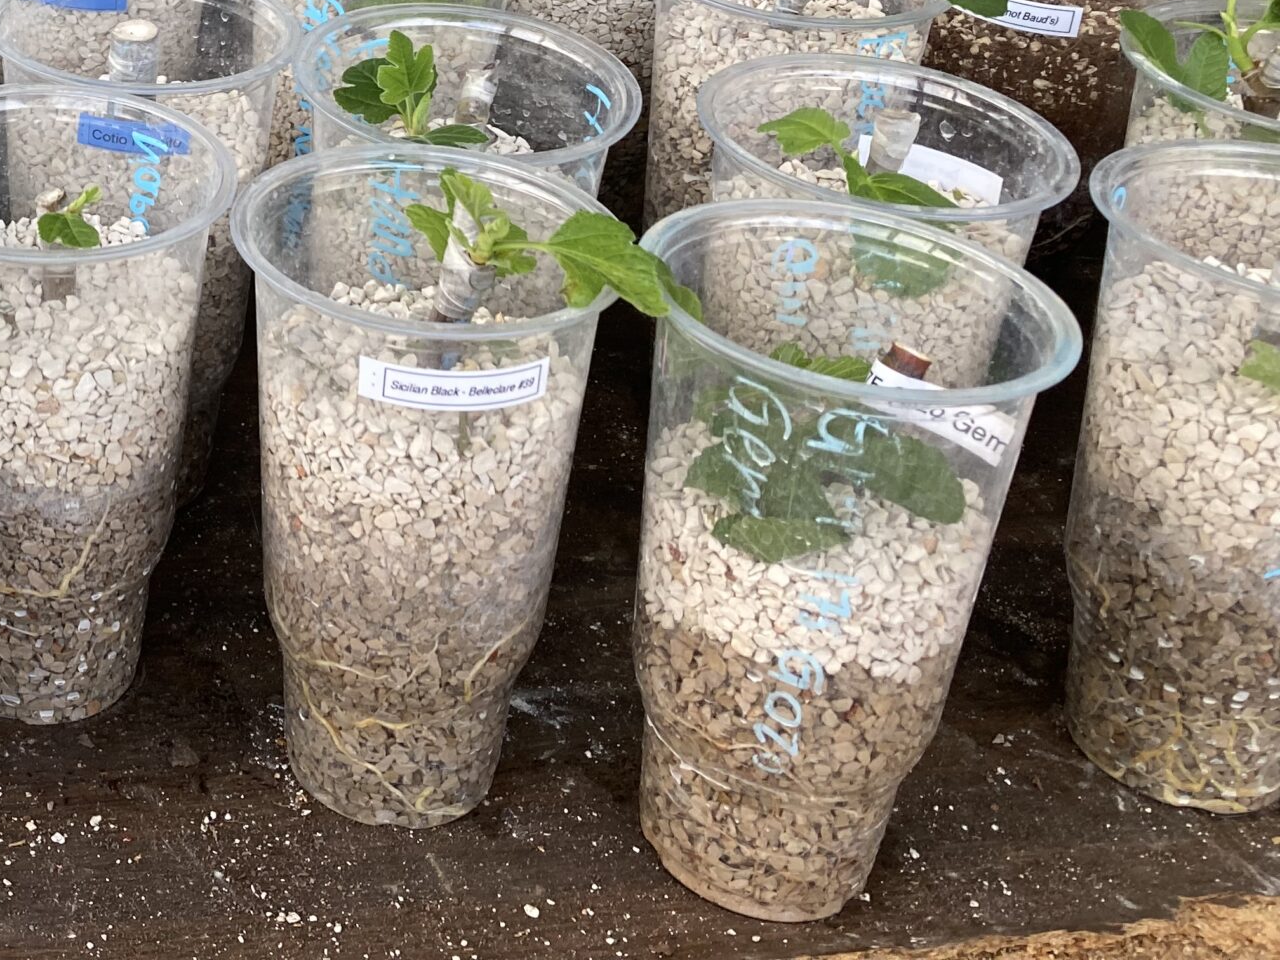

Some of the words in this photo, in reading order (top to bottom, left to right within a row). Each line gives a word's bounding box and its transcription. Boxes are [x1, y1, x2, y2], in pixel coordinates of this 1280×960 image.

[92, 129, 128, 147] Cotio
[390, 380, 428, 395] Sicilian
[431, 384, 460, 397] Black
[518, 377, 536, 390] #39
[752, 647, 825, 775] Gozo
